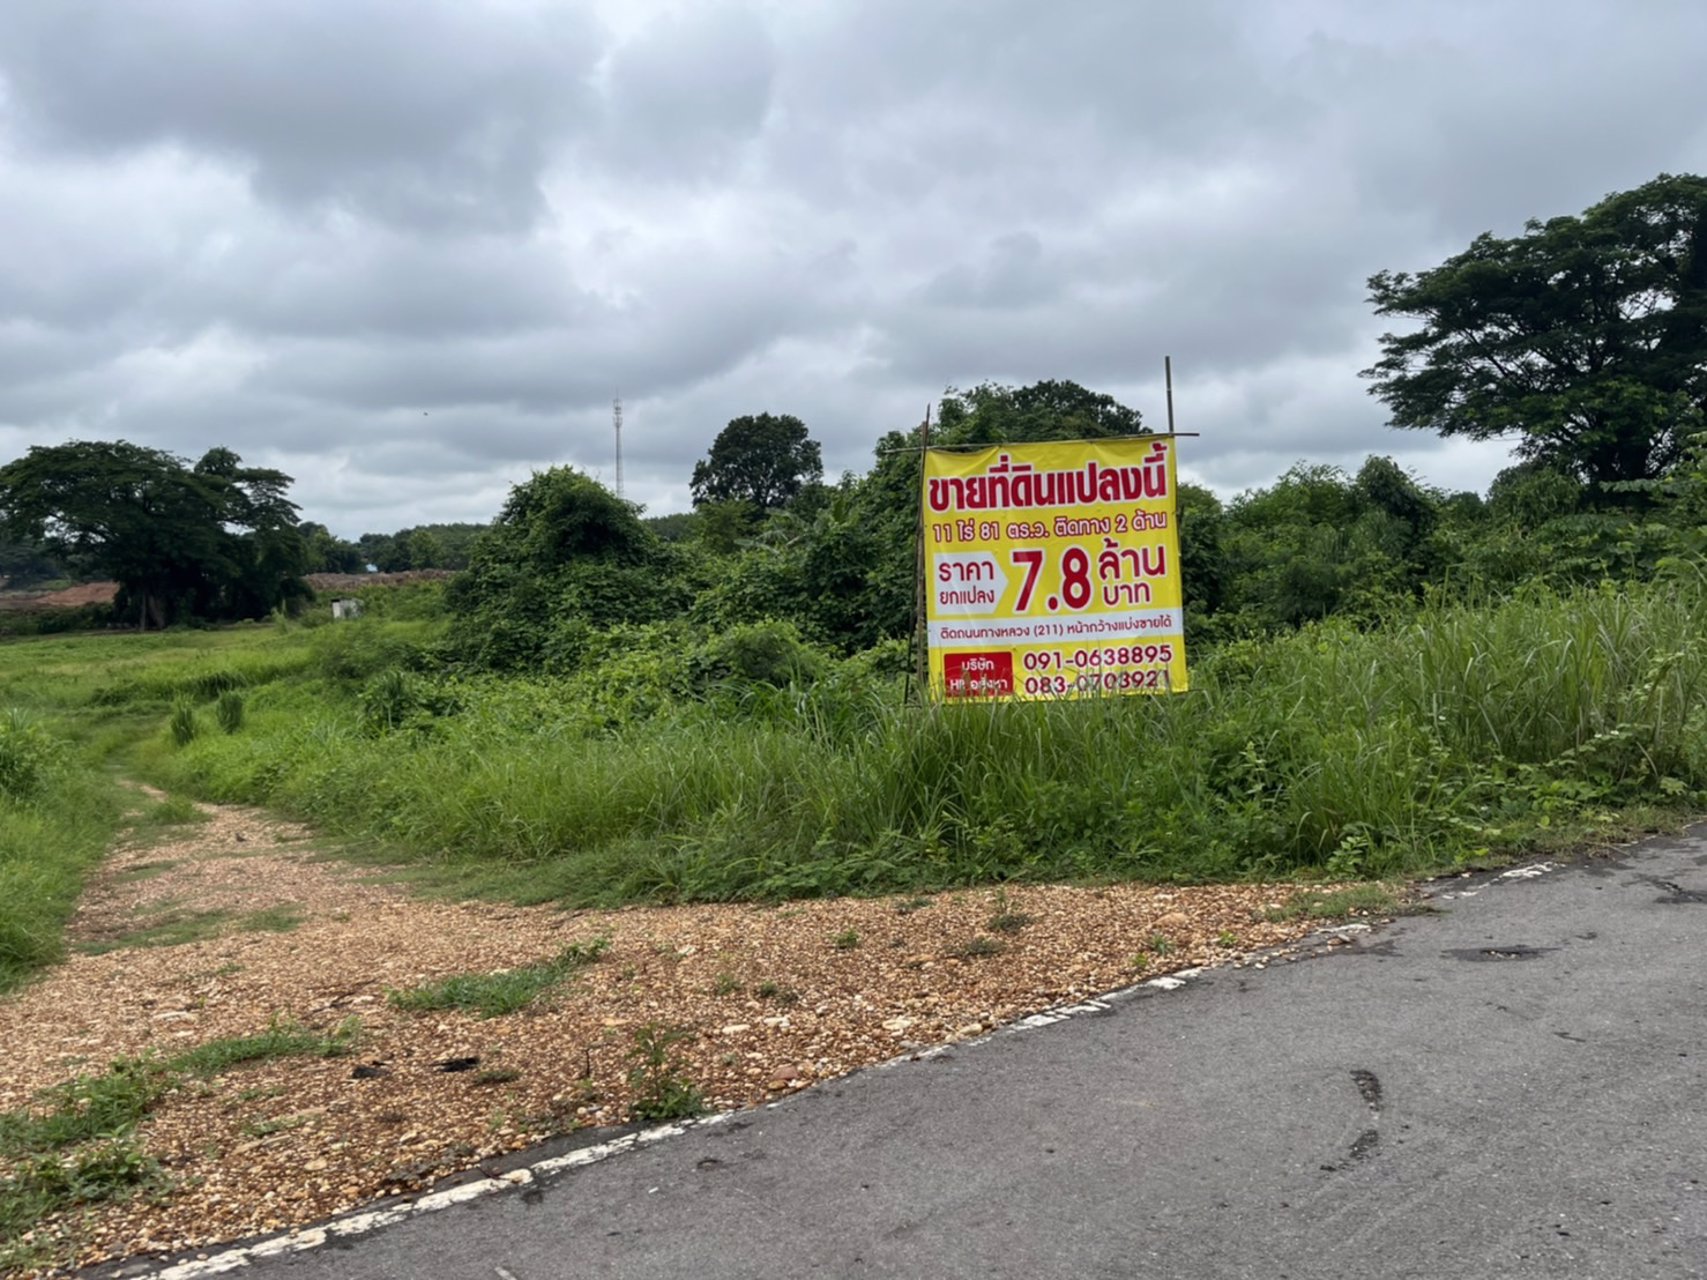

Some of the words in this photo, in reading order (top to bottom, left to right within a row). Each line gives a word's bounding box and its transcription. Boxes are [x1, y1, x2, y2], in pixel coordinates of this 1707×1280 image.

[929, 443, 1168, 511] ขายที่ดินแปลงนี้
[933, 525, 952, 542] 11
[957, 518, 975, 541] ไร่
[980, 522, 1000, 540] 81
[1007, 521, 1049, 539] ตร.ว.
[1055, 516, 1110, 537] ติดทาง
[1116, 514, 1128, 533] 2
[1132, 508, 1167, 531] ด้าน
[938, 561, 994, 582] ราคา
[1099, 538, 1166, 580] ล้าน
[1013, 547, 1092, 612] 7.8
[939, 585, 995, 605] ยกแปลง
[1104, 582, 1150, 606] บาท
[940, 627, 1030, 640] ติดถนนทางหลวง
[1033, 623, 1064, 638] (211)
[1023, 645, 1173, 671] 091-0638895
